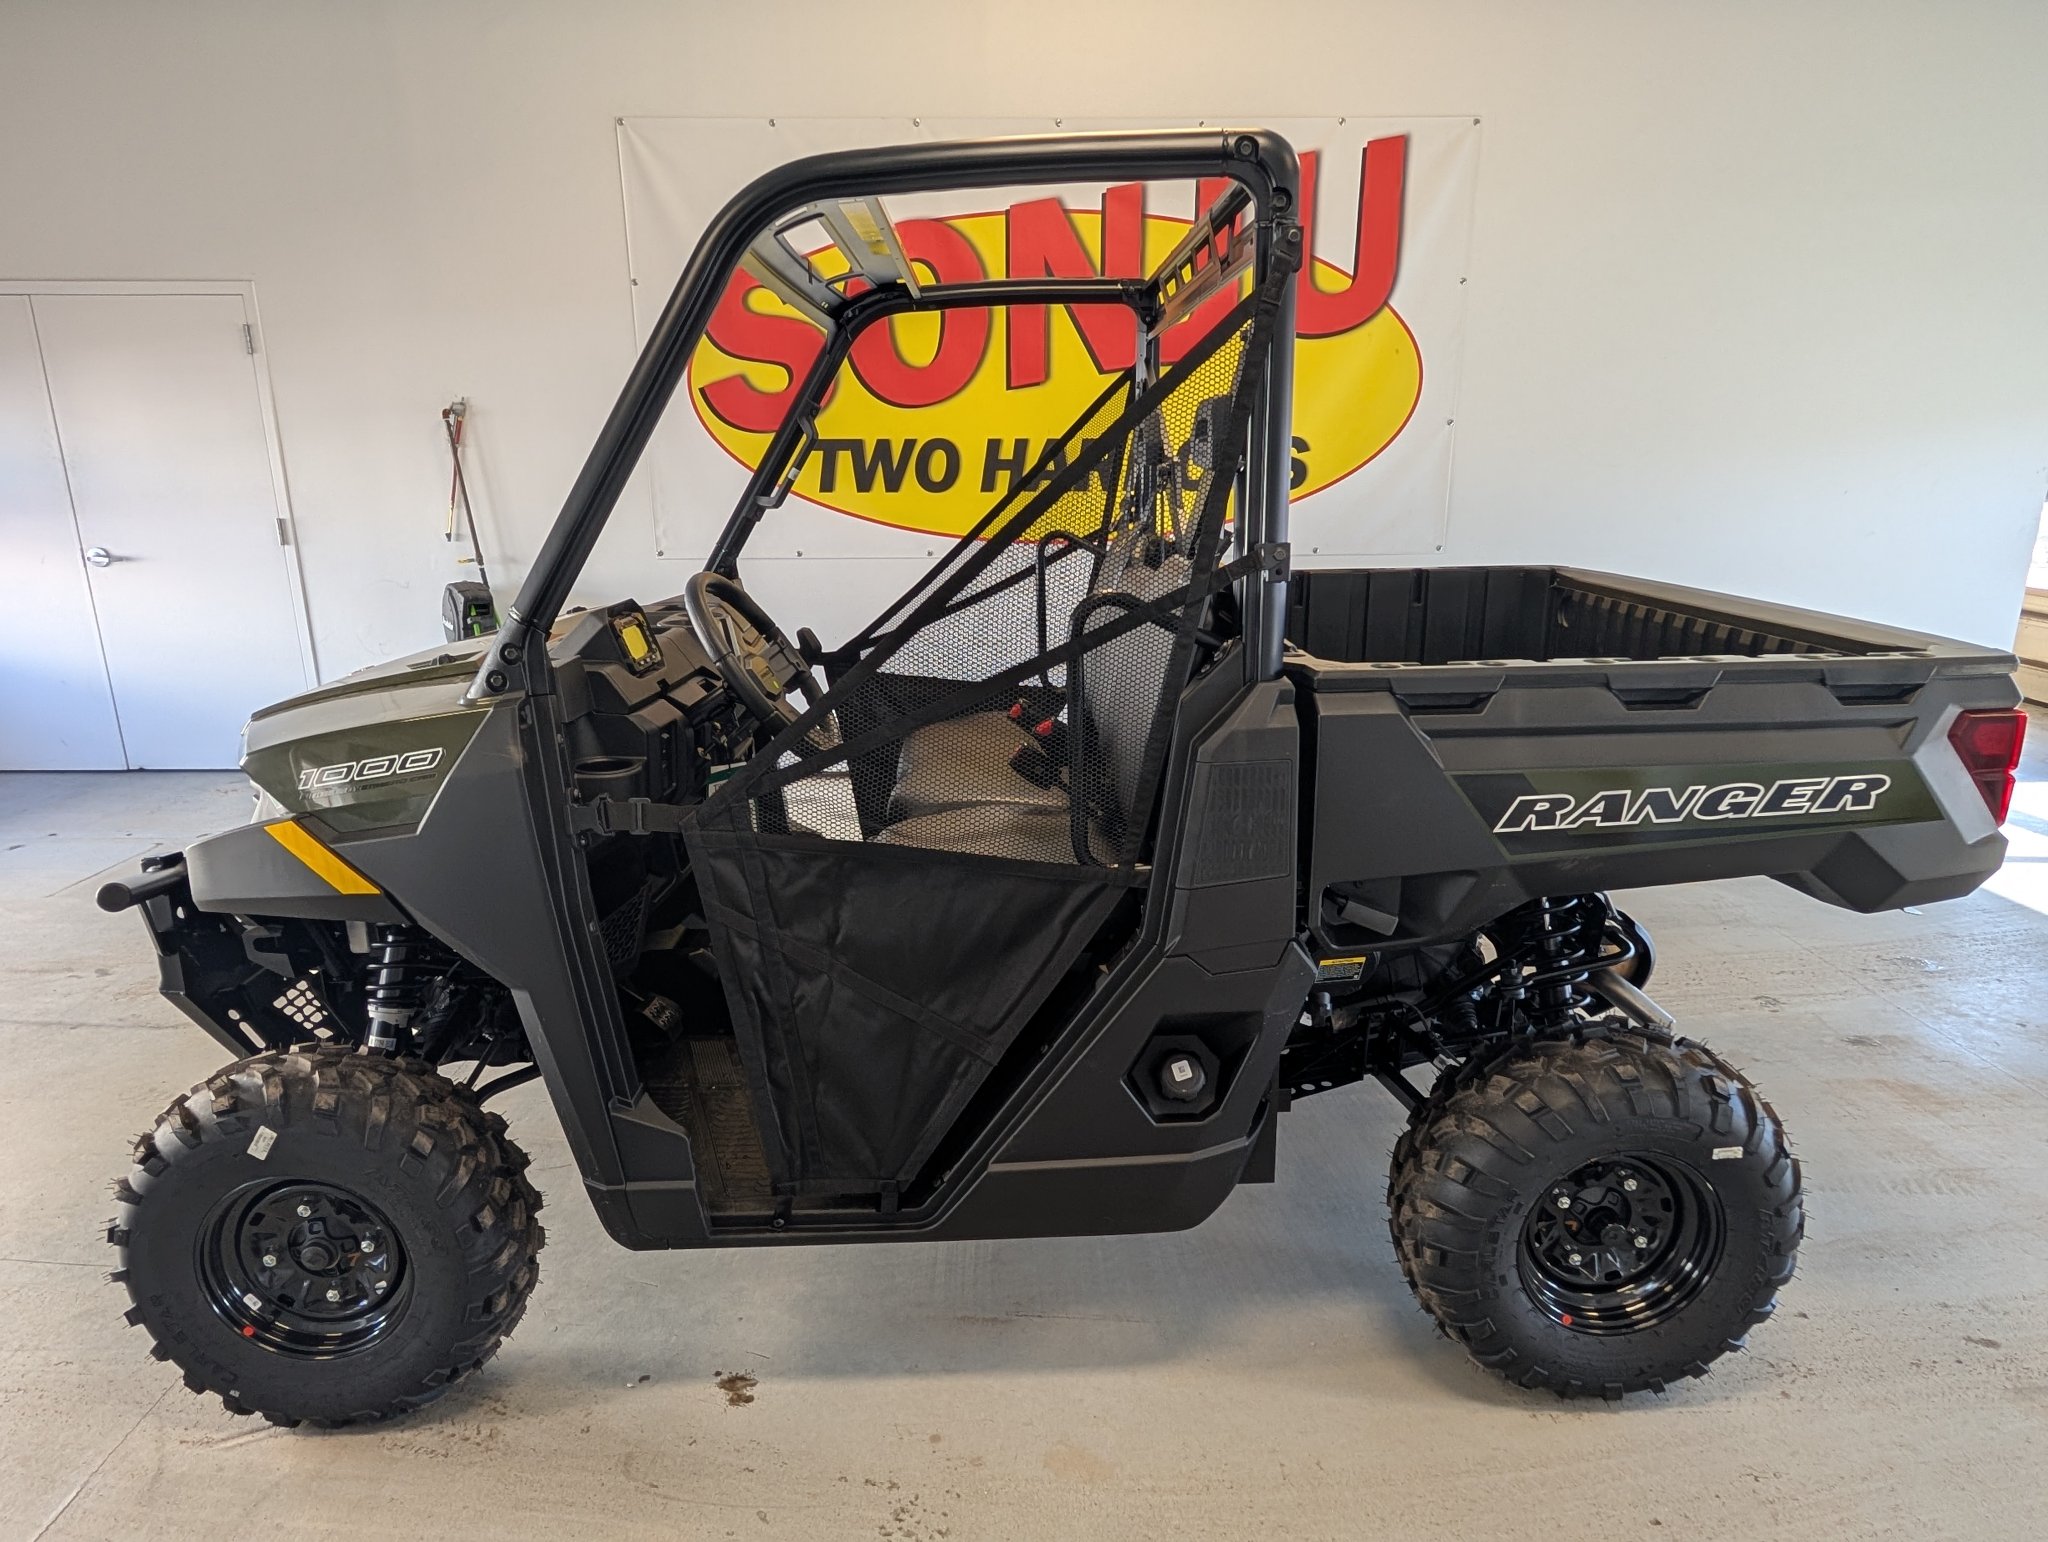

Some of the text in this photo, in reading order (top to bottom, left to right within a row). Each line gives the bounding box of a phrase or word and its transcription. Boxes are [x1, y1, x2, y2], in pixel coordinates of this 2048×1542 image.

[813, 436, 1309, 494] TWO HARS
[298, 747, 443, 789] 1000
[1493, 774, 1891, 833] RANGER
